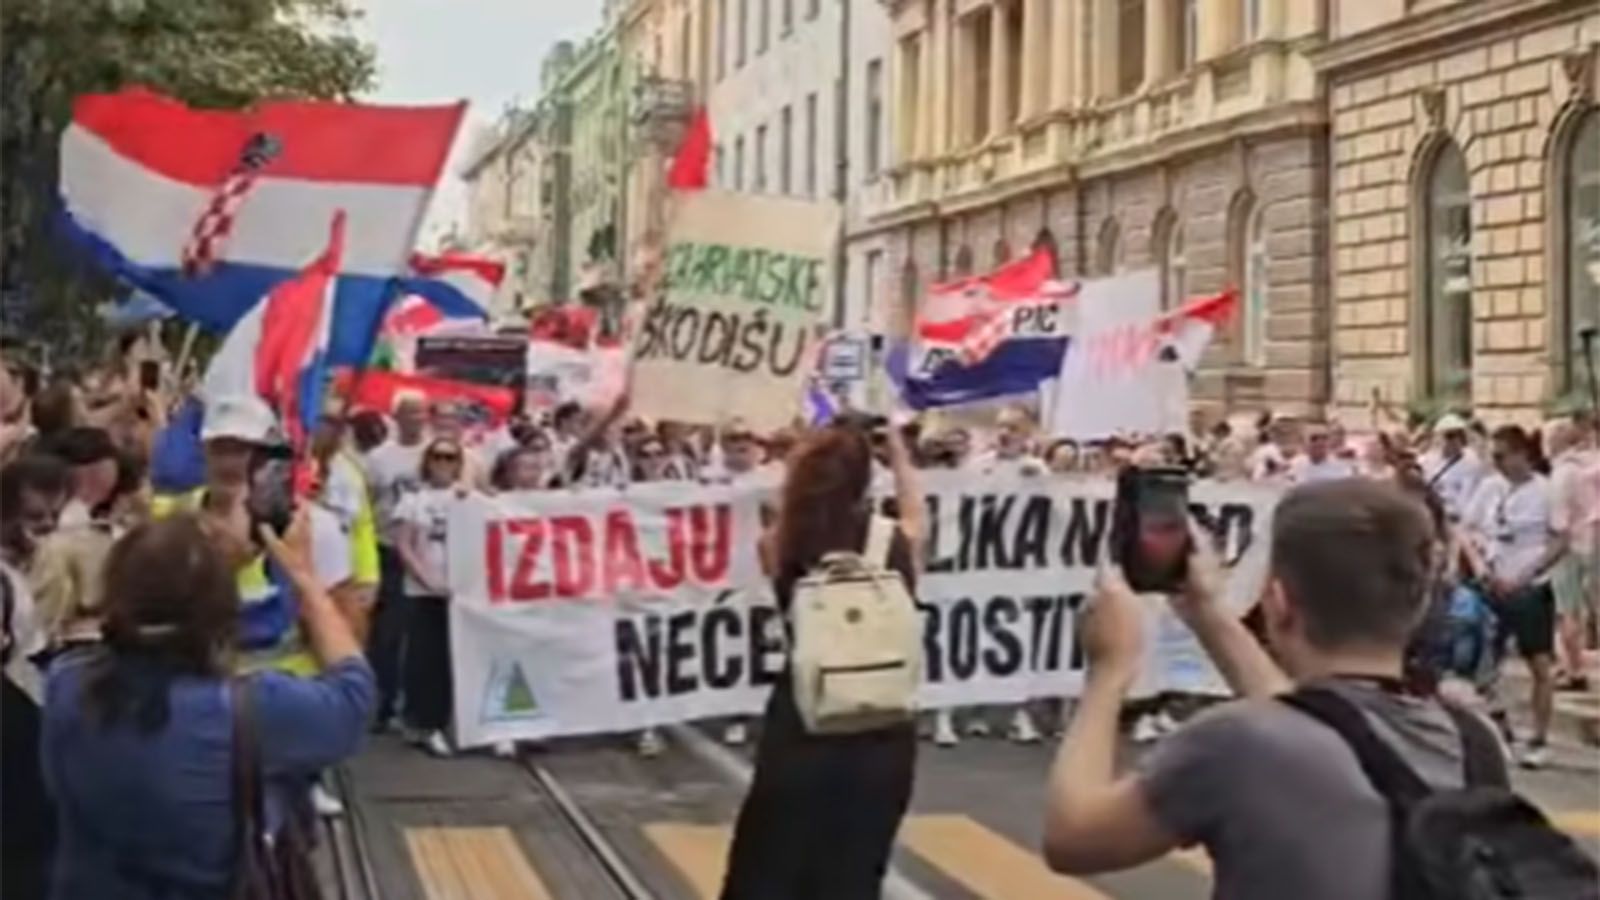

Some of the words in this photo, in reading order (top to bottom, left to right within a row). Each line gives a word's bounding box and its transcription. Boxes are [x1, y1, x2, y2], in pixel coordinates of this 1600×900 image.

[484, 504, 732, 606] IZDAJU
[615, 590, 785, 702] NEĆE
[923, 593, 1087, 682] ROSTIT
